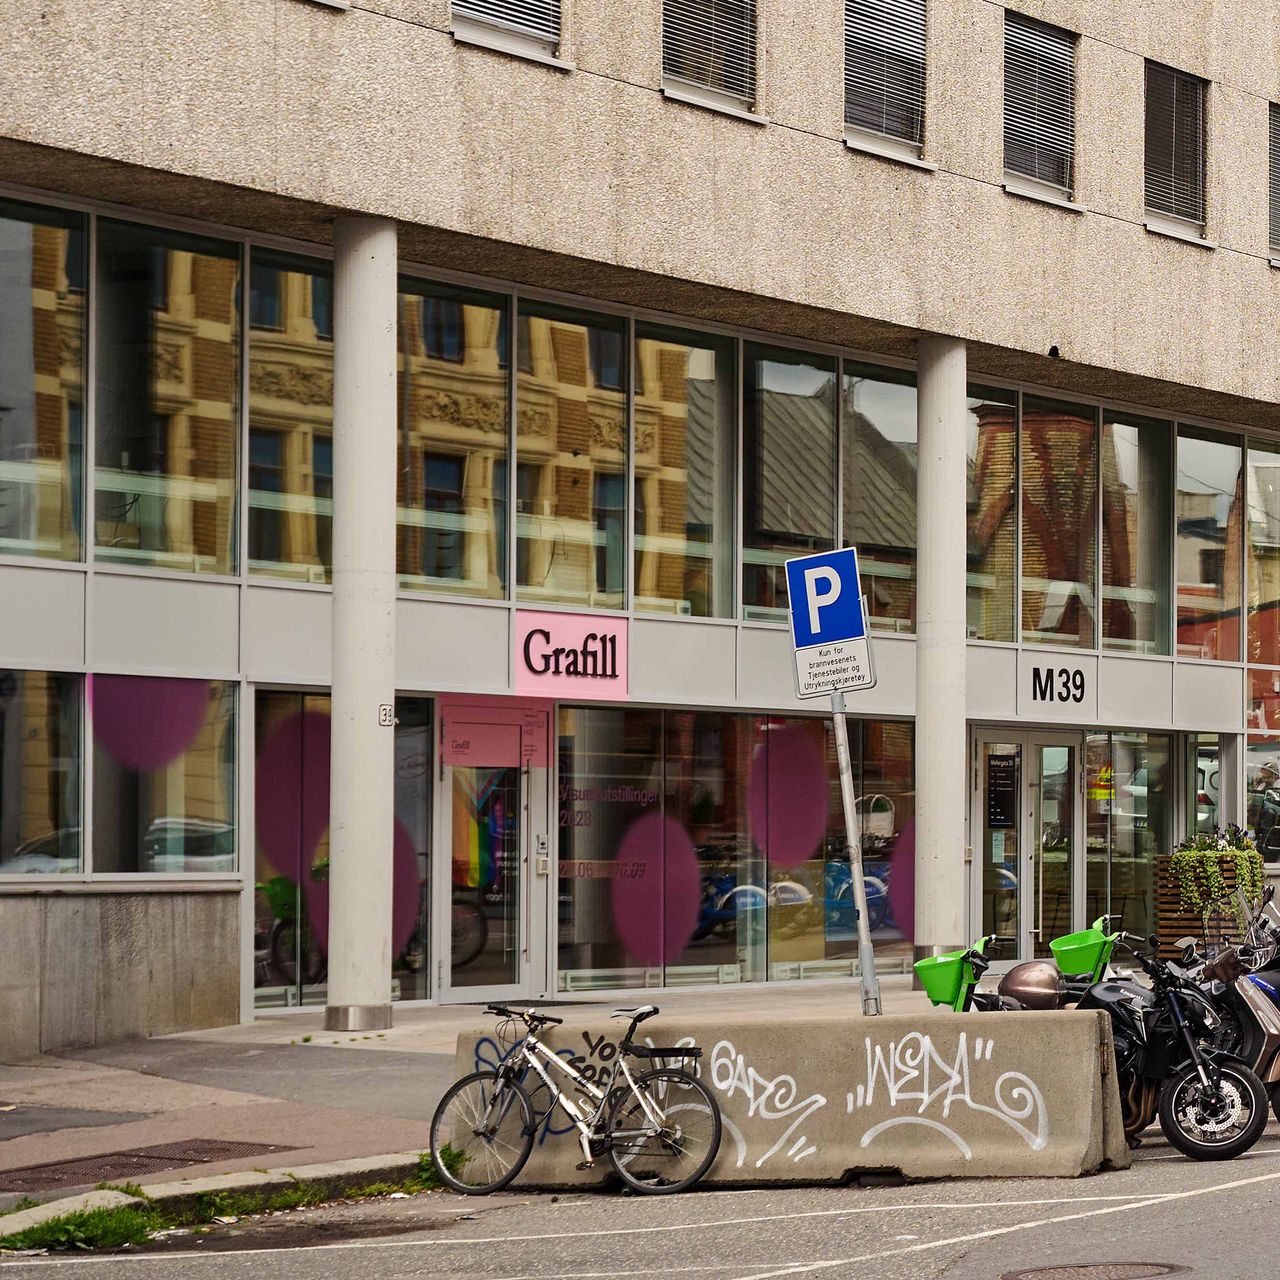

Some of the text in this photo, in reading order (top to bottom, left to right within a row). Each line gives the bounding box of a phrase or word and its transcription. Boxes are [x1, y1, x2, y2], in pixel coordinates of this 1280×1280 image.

[804, 566, 842, 634] P
[523, 627, 619, 680] Grafill
[818, 646, 844, 658] Kun for
[808, 655, 857, 670] brannvesenets
[808, 664, 860, 680] Tjenestebiler og
[804, 673, 866, 690] Utrykningskjøretøy
